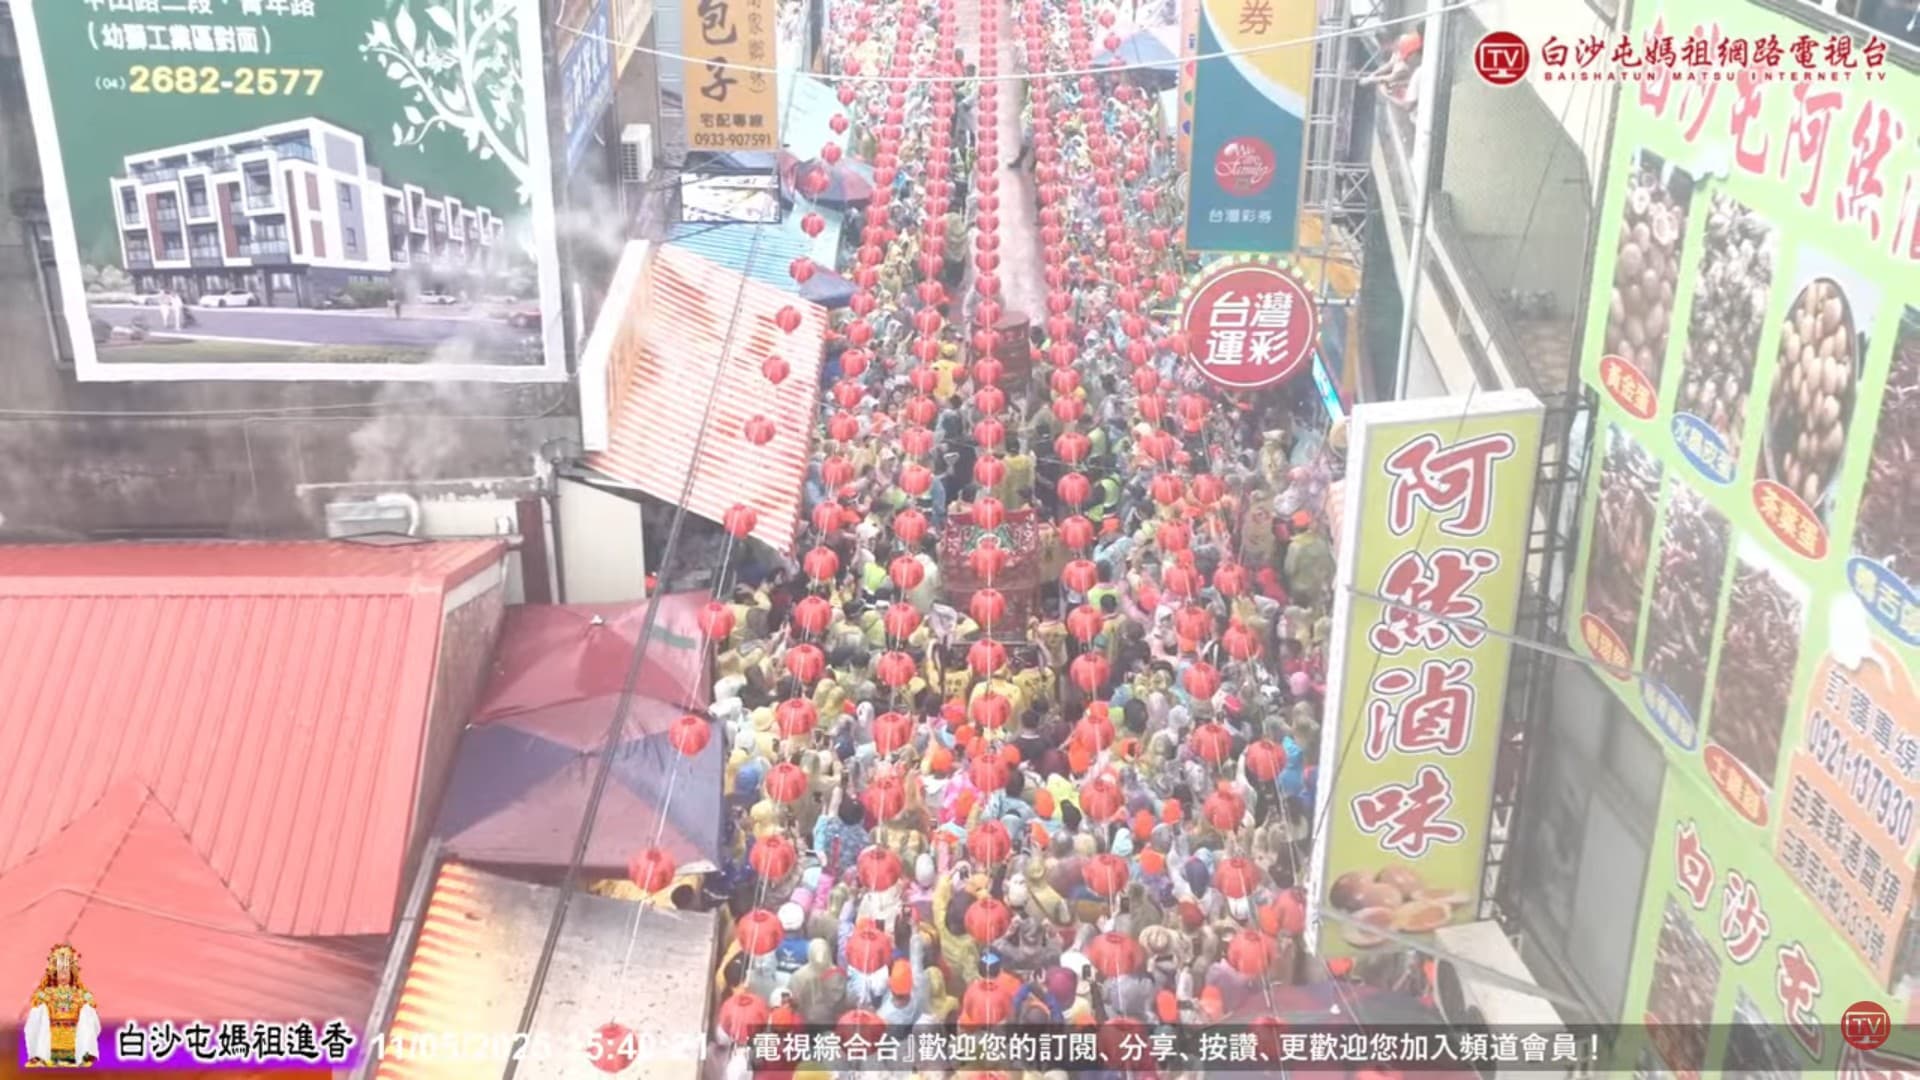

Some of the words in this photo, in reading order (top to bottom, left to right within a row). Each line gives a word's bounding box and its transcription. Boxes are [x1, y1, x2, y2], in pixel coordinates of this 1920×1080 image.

[96, 76, 126, 90] (04)
[129, 65, 324, 95] 2682-2577
[1209, 208, 1272, 223] 台灣彩券
[1211, 291, 1292, 328] 台灣
[1204, 329, 1289, 366] 運彩
[1350, 432, 1515, 858] 阿然滷味
